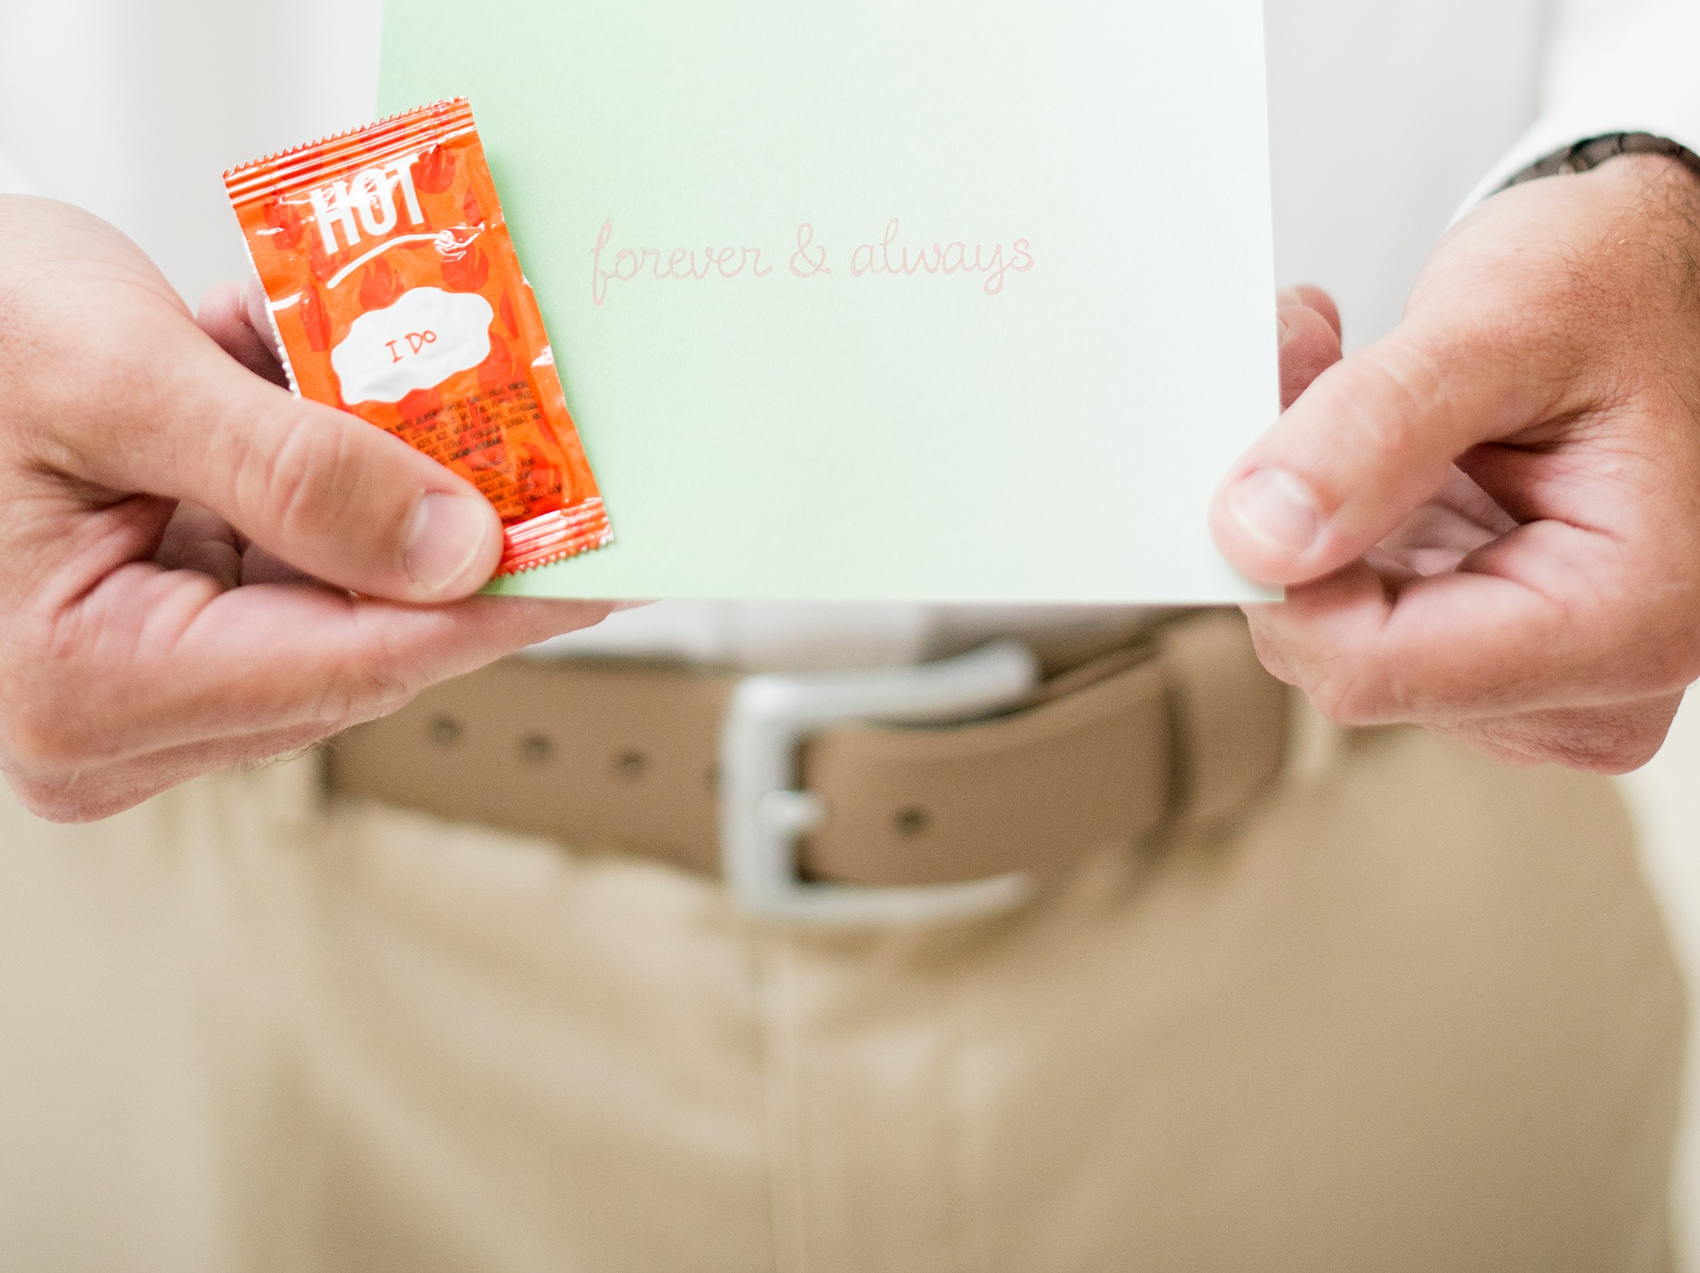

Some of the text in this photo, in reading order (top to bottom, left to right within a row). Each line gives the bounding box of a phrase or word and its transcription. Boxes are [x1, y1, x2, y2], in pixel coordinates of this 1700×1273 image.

[309, 153, 425, 255] HOT
[591, 217, 1034, 307] forever & always
[385, 340, 404, 364] I
